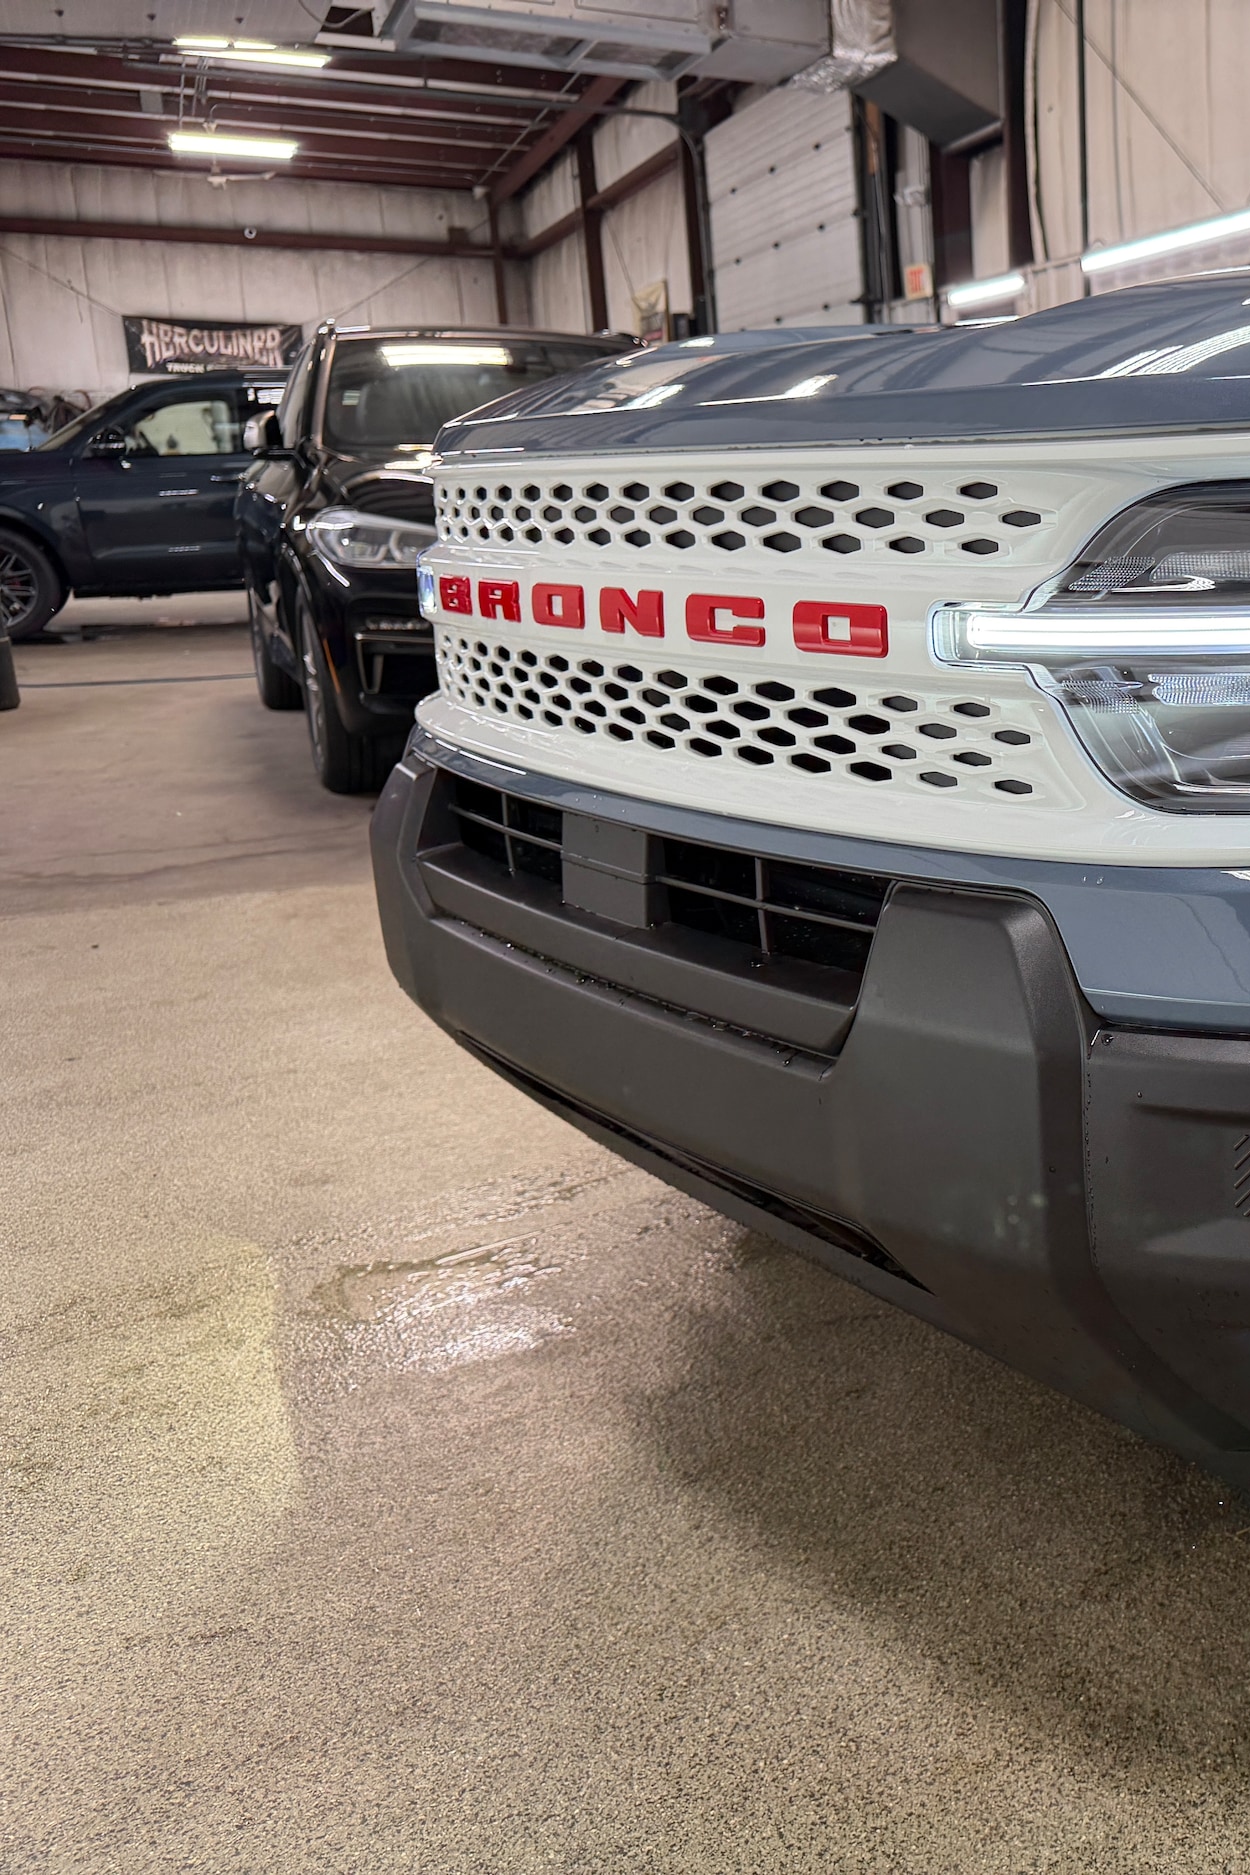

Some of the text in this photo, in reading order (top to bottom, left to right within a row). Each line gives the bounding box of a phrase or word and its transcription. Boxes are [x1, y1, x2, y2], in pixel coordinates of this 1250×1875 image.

[141, 318, 284, 369] HERCULINER
[165, 362, 206, 374] TRUCK
[439, 574, 890, 658] BRONCO
